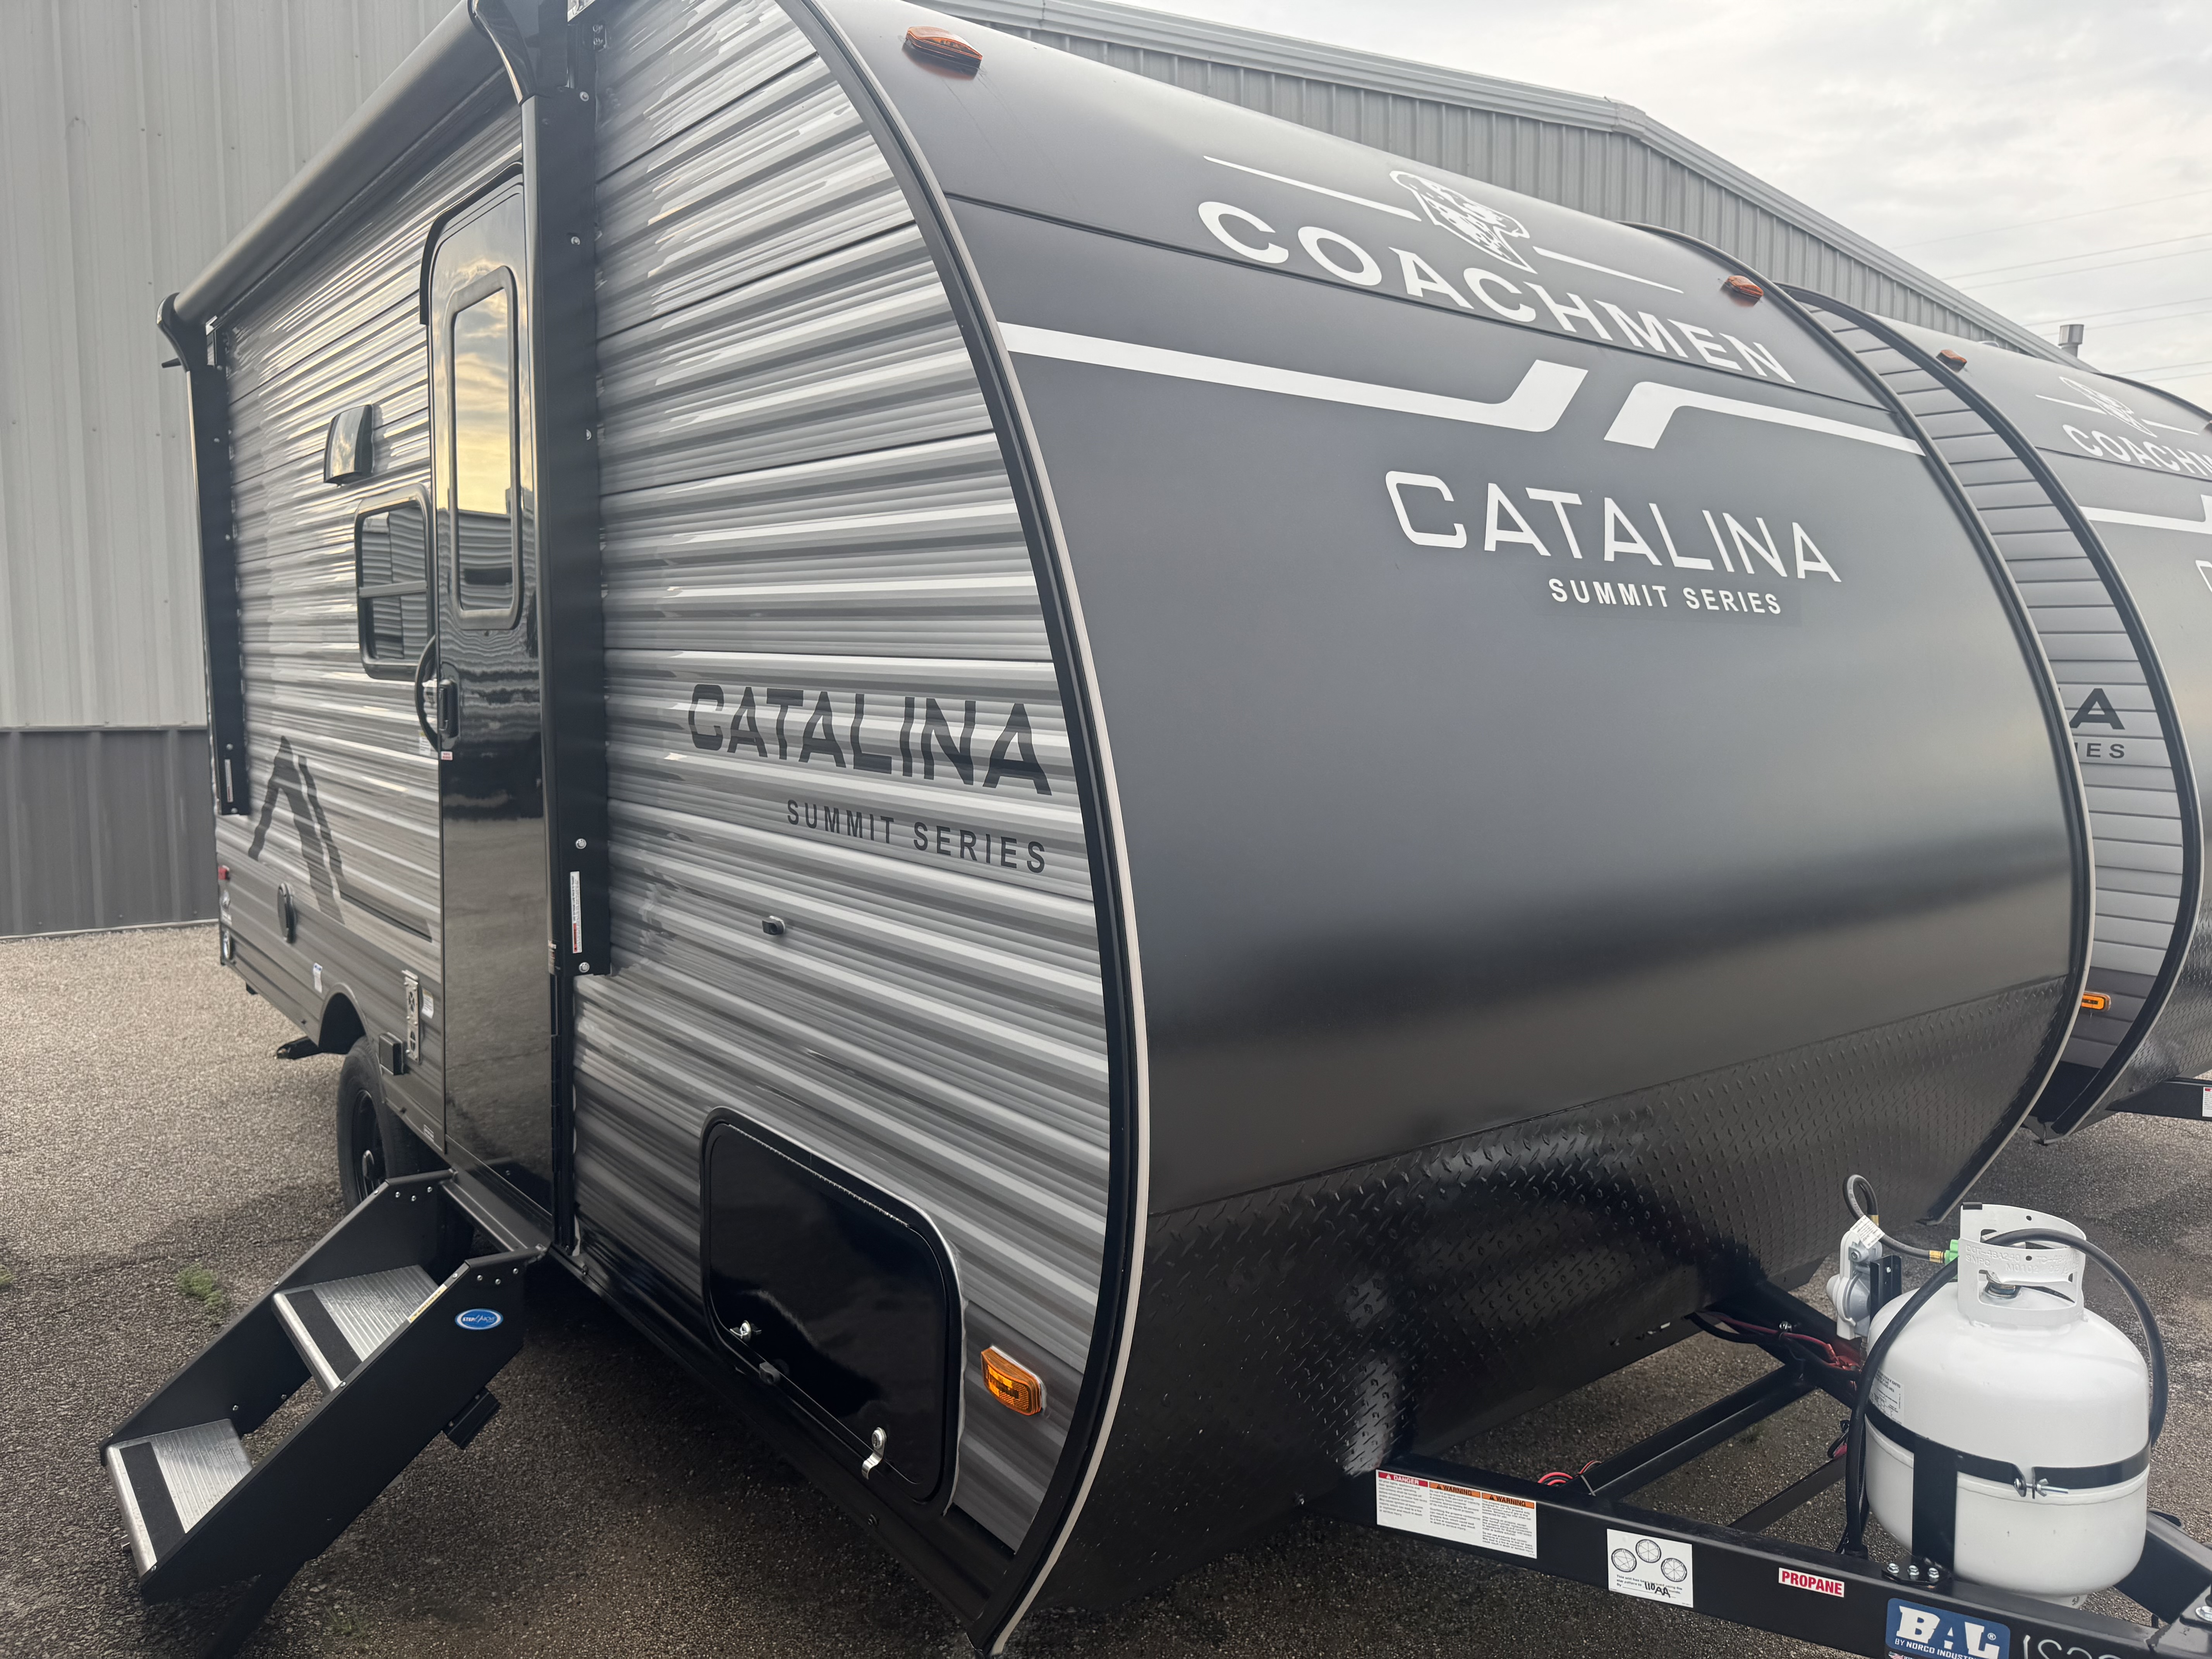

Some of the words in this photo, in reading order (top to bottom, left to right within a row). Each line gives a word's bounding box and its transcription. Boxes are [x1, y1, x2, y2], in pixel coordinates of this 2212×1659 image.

[1198, 201, 1795, 383] COACHMEN
[1385, 471, 1842, 582] CATALINA
[1549, 578, 1668, 608] SUMMIT
[1683, 587, 1782, 615] SERIES
[2058, 688, 2125, 730] A
[688, 684, 1052, 795] CATALINA
[787, 799, 894, 844] SUMMIT
[913, 821, 1045, 873] SERIES
[1393, 1475, 1419, 1486] DANGER
[1443, 1485, 1472, 1496] WARNING
[1496, 1496, 1526, 1506] WARNING
[1782, 1570, 1842, 1595] PROPANE
[1896, 1605, 2000, 1659] BAL
[1906, 1641, 1936, 1654] NORCO
[1937, 1649, 1977, 1659] INDUST
